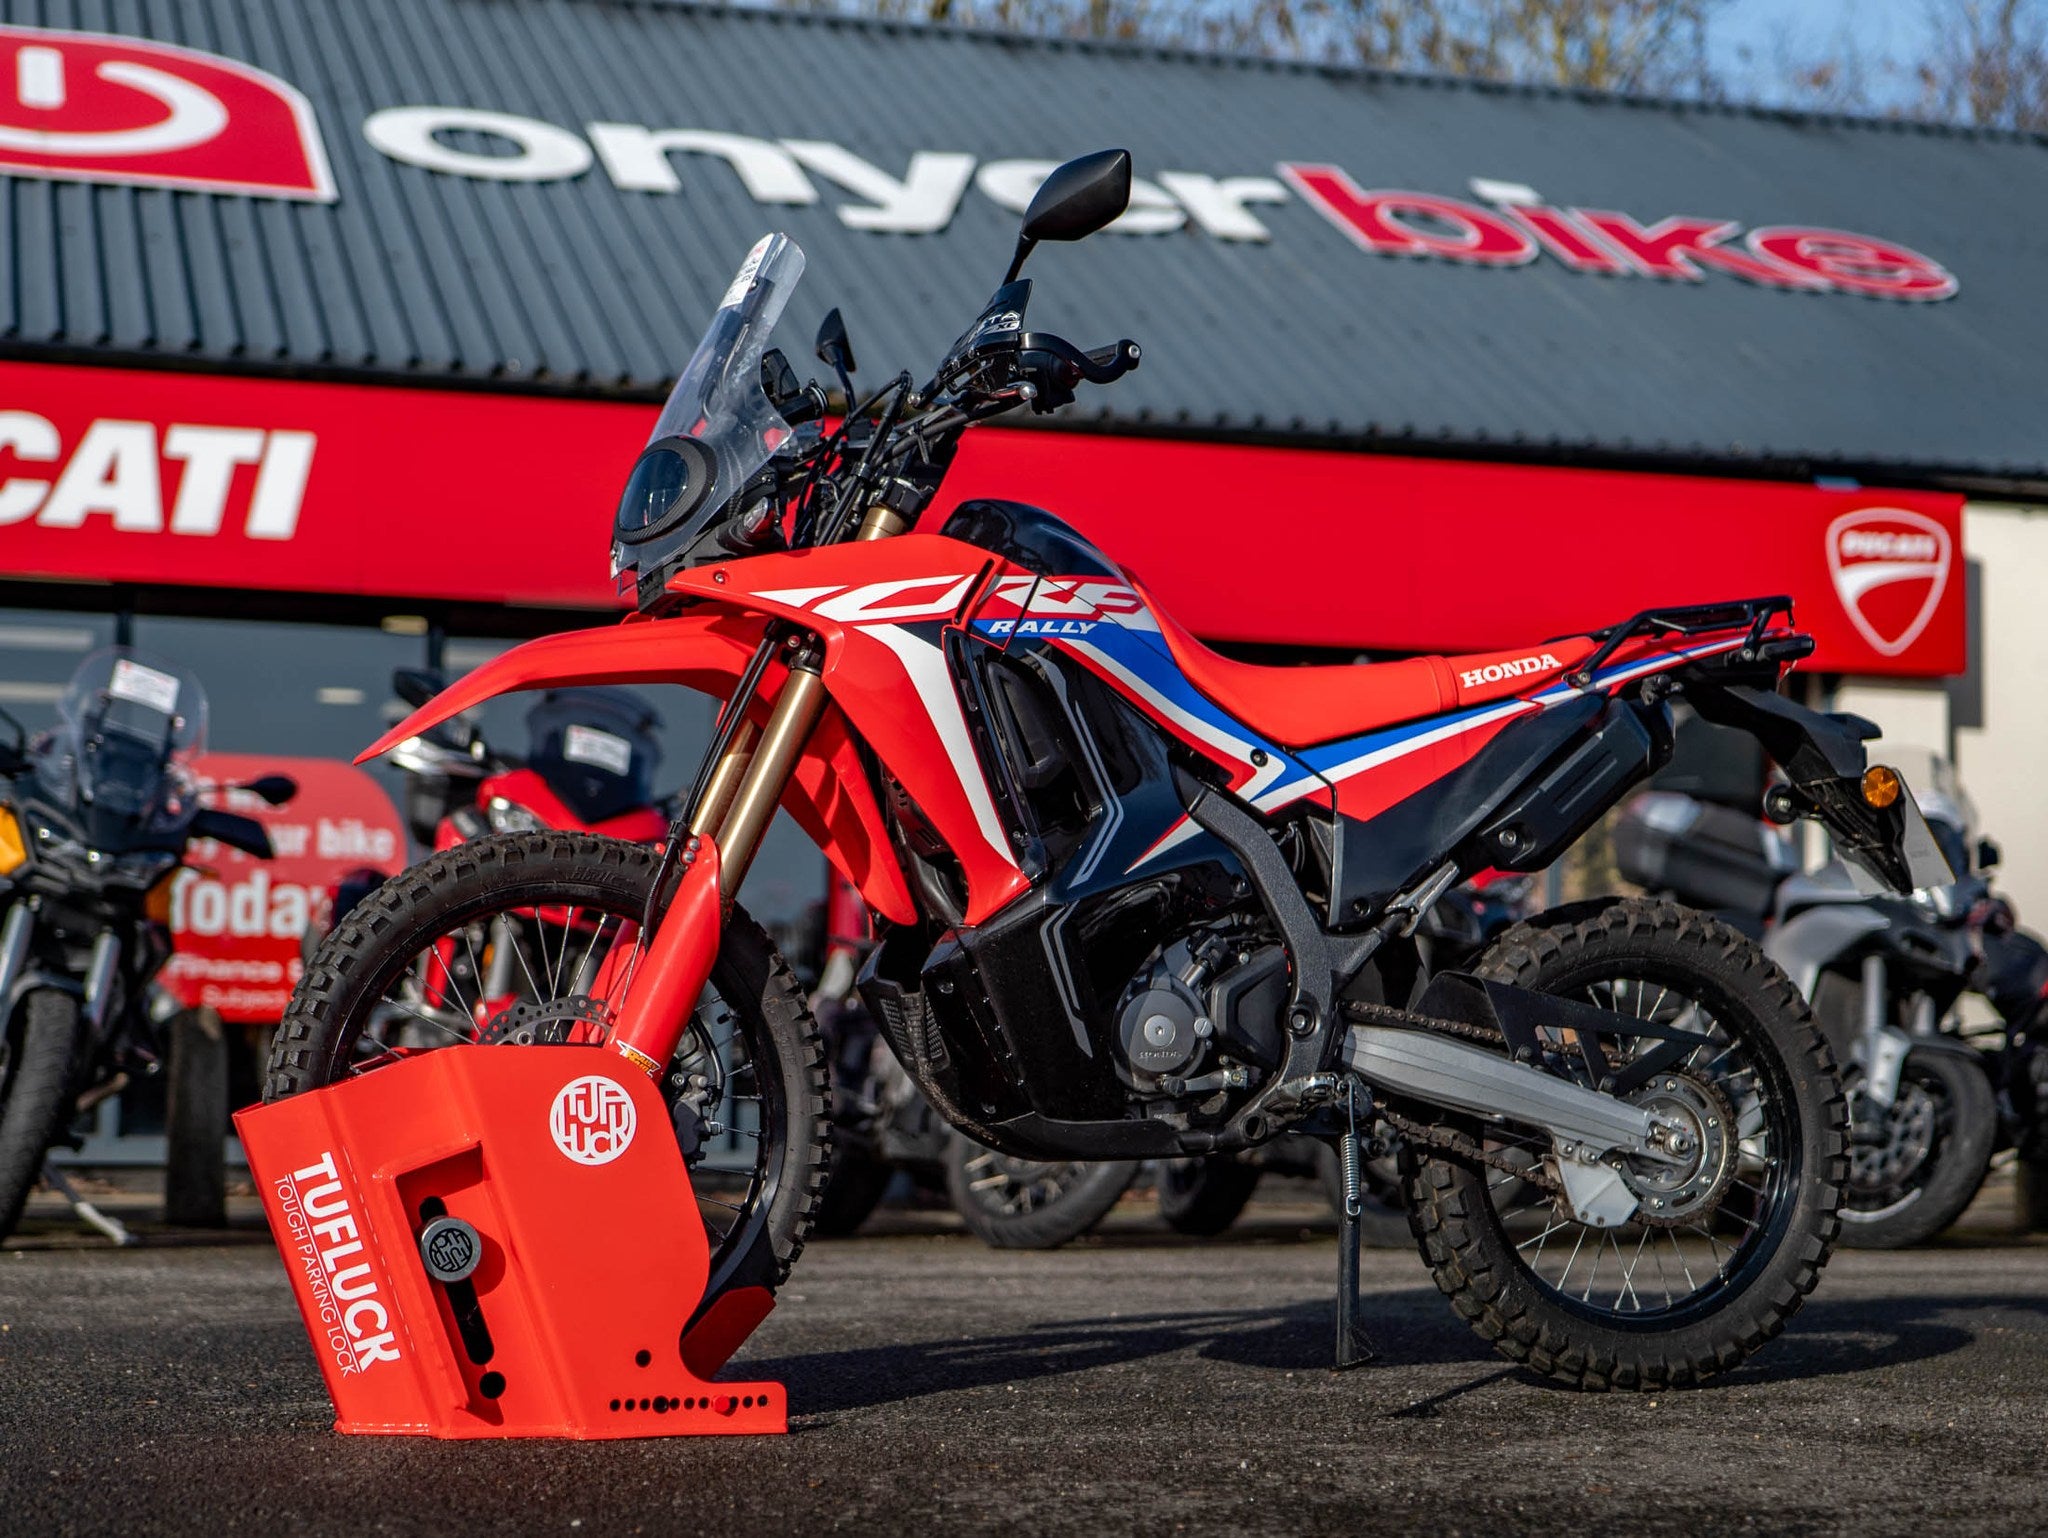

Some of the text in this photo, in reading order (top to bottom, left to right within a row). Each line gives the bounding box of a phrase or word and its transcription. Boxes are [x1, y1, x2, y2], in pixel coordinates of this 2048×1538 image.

[1840, 529, 1937, 560] DUCATI
[988, 620, 1098, 634] RALLY
[1460, 653, 1562, 688] HONDA
[316, 817, 396, 860] bike
[274, 1174, 356, 1377] TOUGH PARKING LOCK
[294, 1151, 401, 1373] TUFLUCK
